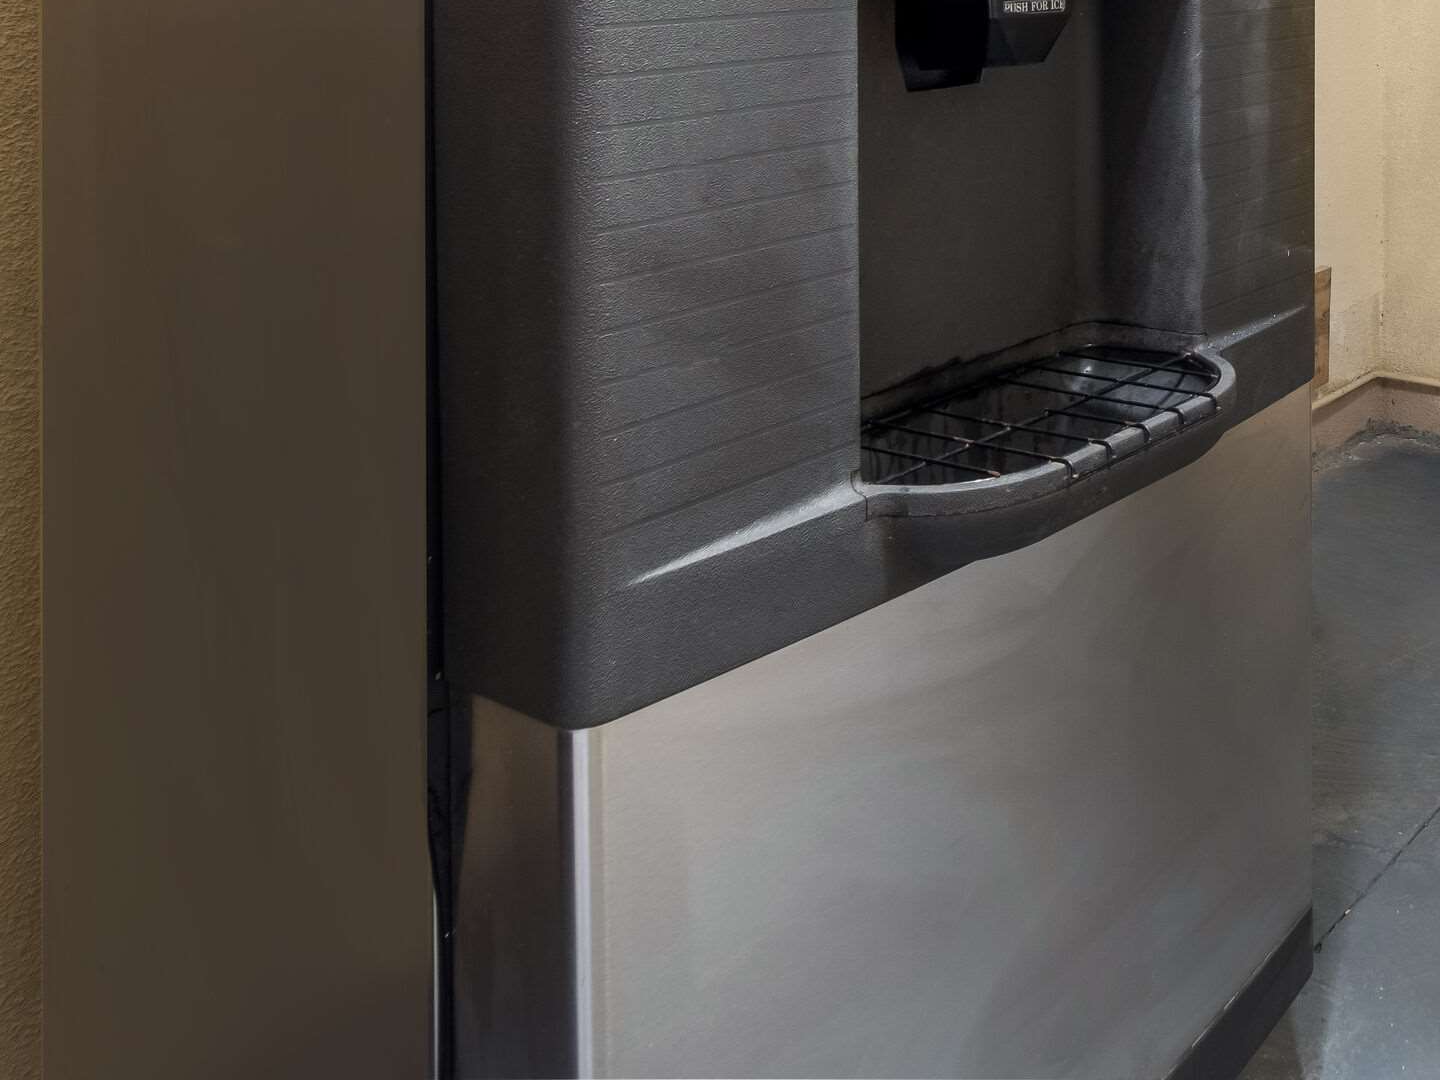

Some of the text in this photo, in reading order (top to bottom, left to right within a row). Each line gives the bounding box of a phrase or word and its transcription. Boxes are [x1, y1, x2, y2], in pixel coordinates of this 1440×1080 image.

[1004, 0, 1066, 13] PUSH FOR ICE
